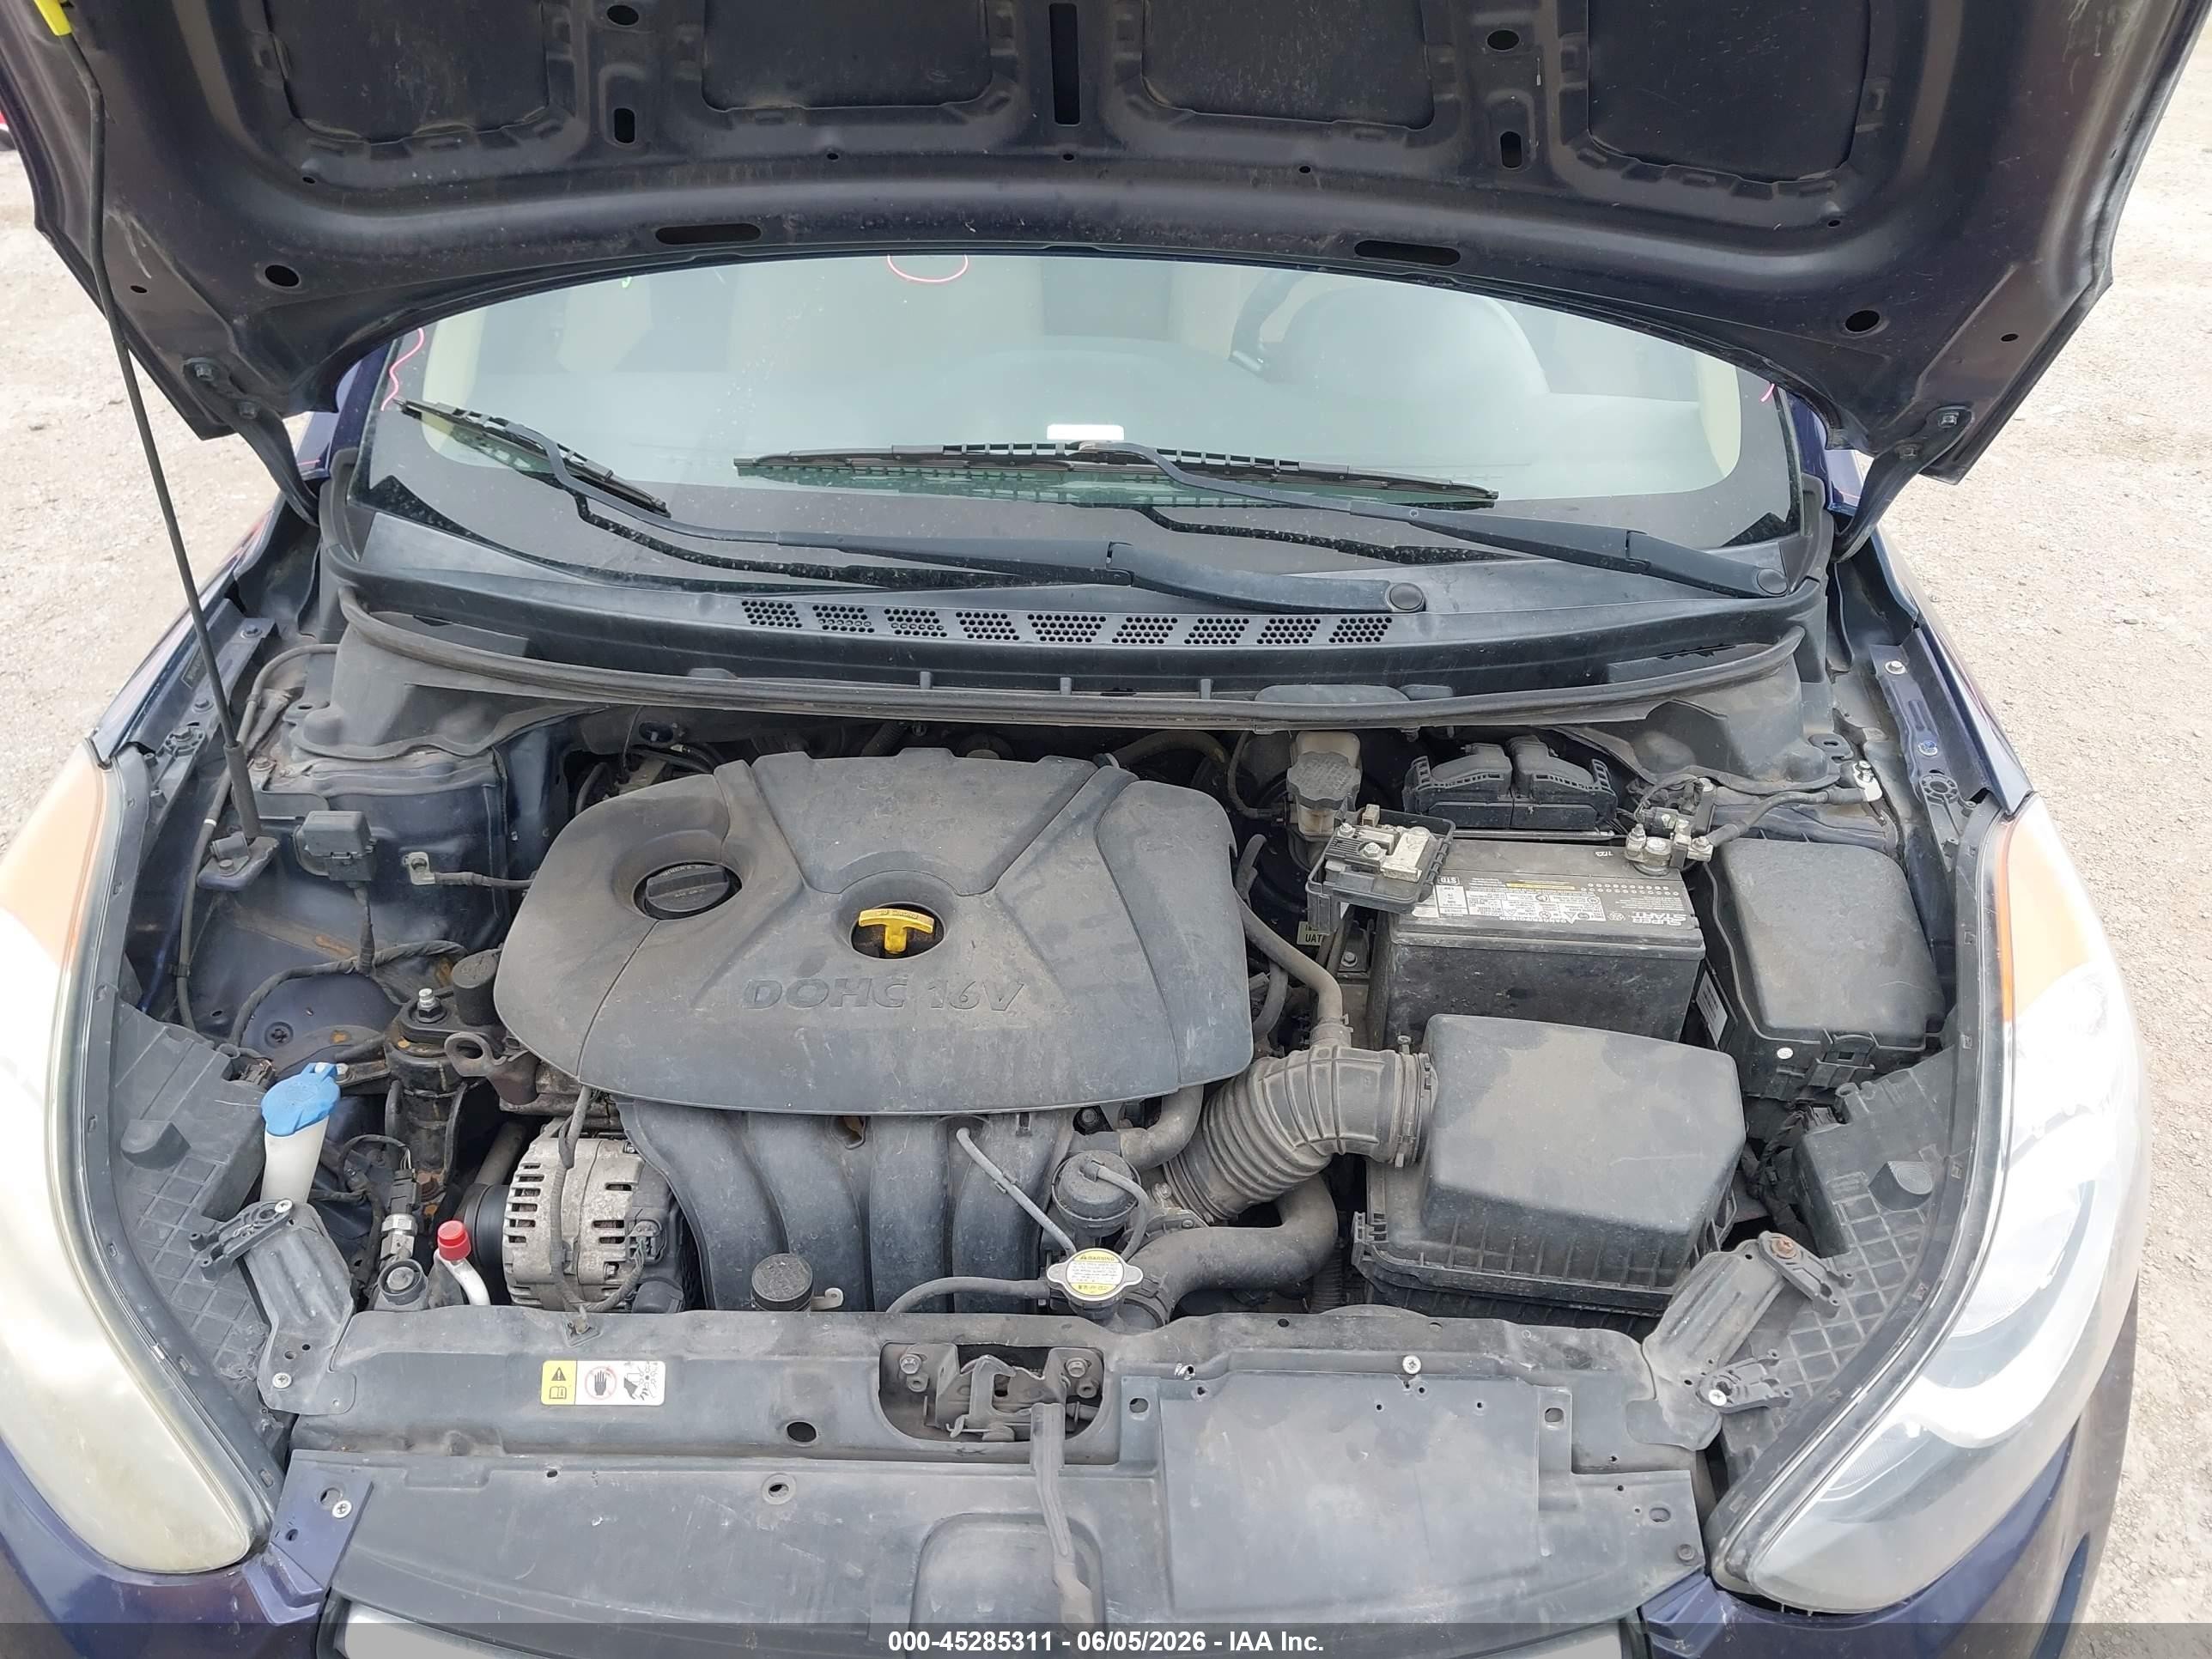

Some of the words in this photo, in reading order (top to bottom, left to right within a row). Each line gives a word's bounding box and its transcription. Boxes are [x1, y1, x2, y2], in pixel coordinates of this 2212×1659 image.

[1631, 911, 1687, 922] START
[1632, 918, 1682, 927] SUPER
[742, 977, 908, 1011] DOHC
[927, 980, 1025, 1012] 16V
